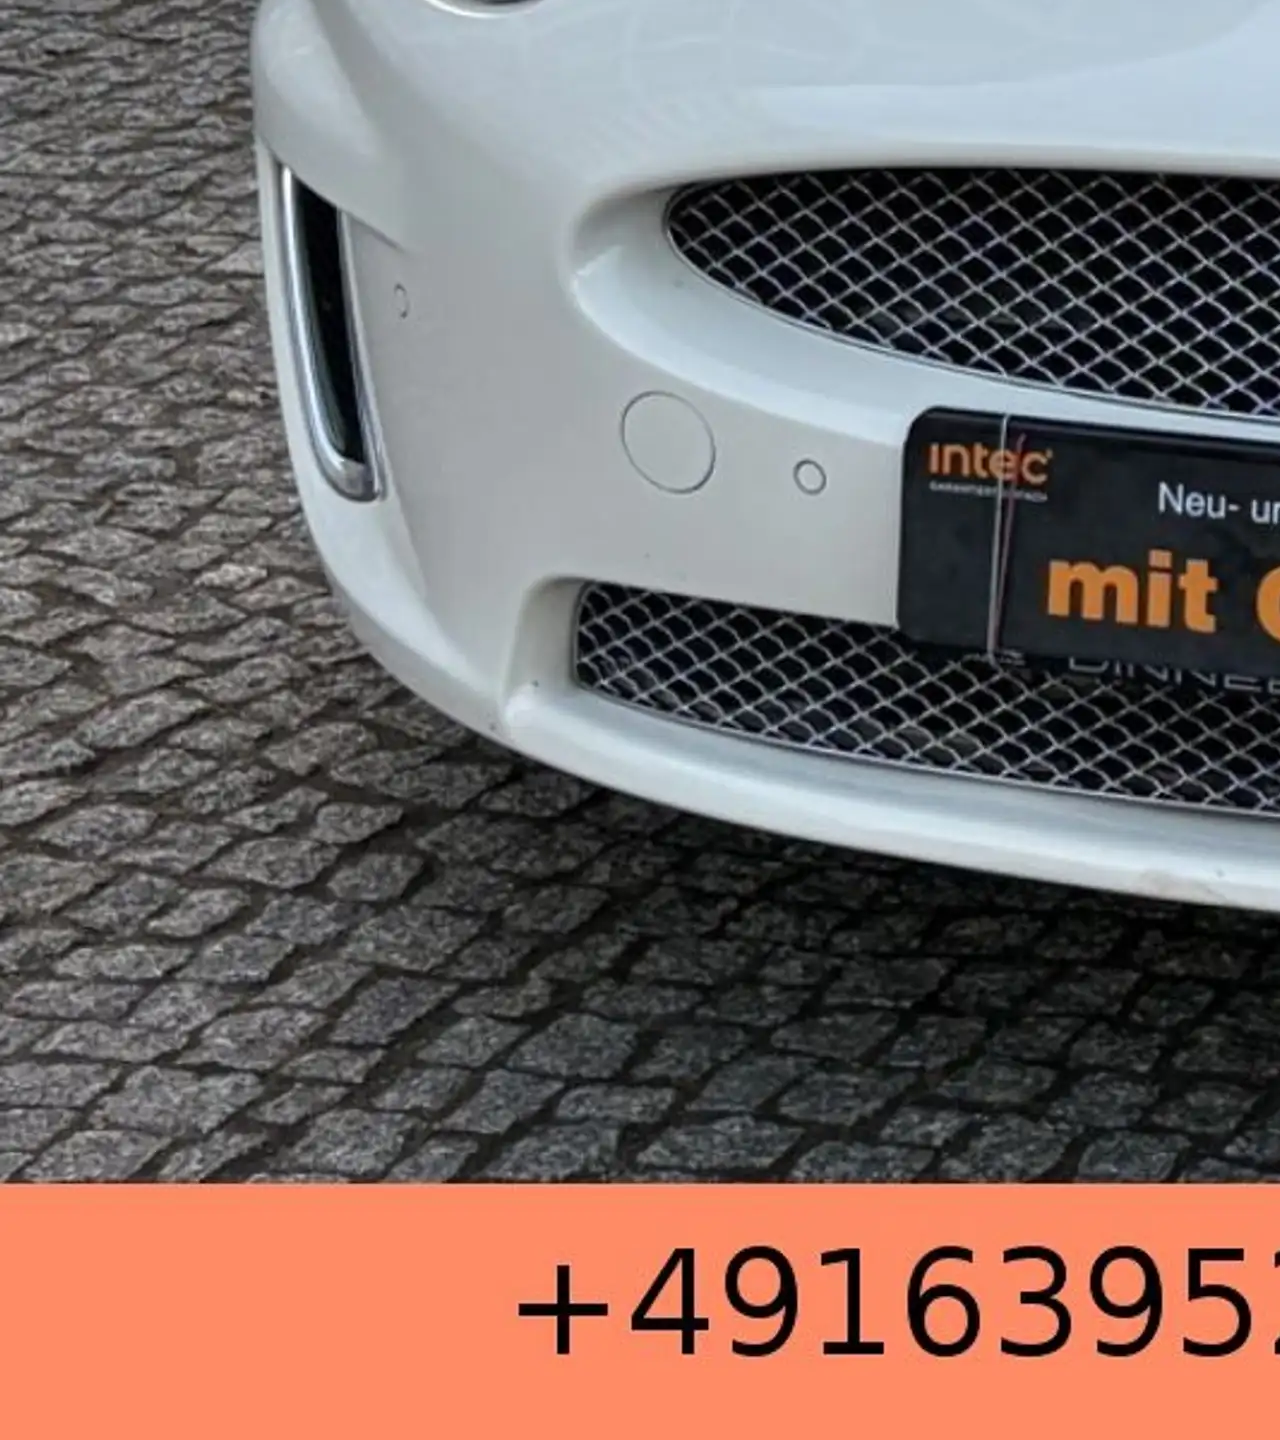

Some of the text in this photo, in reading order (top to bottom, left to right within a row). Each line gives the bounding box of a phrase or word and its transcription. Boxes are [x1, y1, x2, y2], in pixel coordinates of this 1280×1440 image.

[929, 442, 1049, 486] intec
[1157, 481, 1240, 520] Neu-
[1047, 549, 1219, 634] mit
